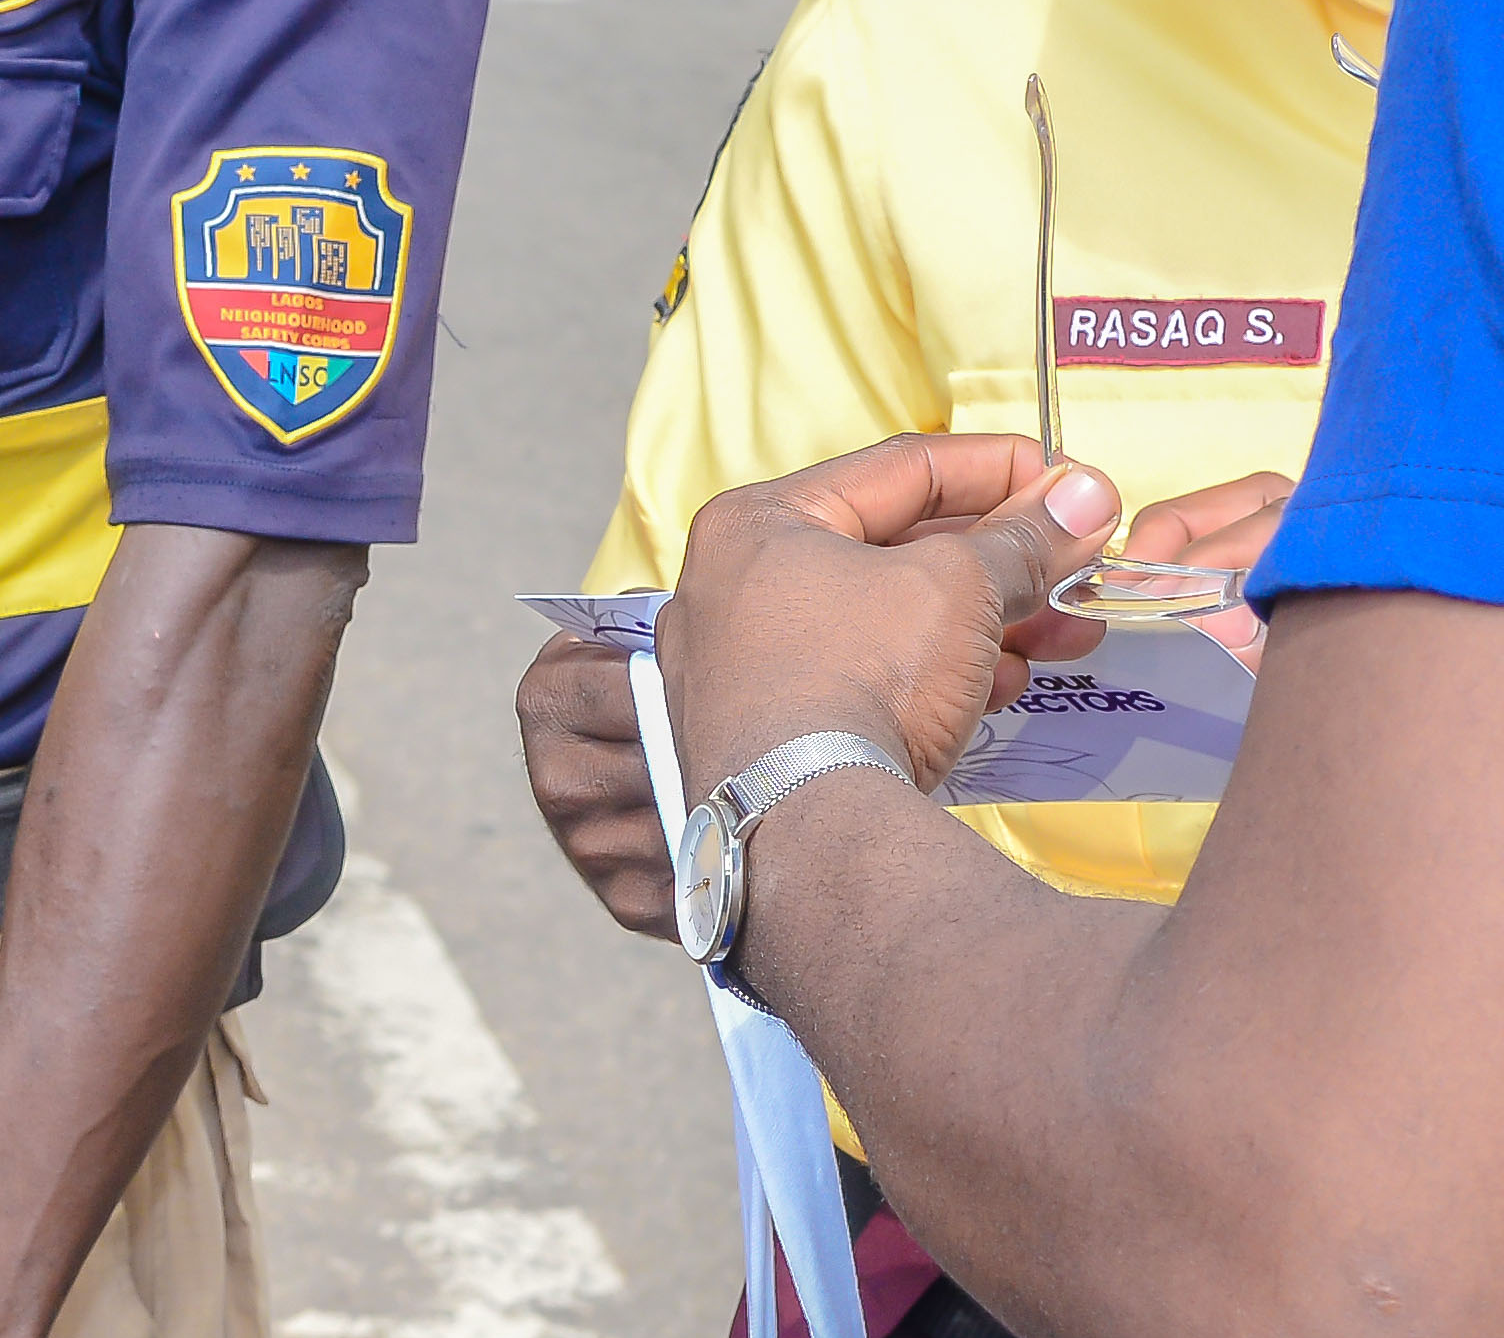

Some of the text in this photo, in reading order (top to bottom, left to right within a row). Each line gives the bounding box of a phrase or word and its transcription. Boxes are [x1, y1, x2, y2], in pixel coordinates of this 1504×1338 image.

[271, 293, 325, 311] LAGOS
[220, 308, 367, 335] NEIGHBOURHOOD
[1069, 308, 1284, 349] RASAQ S.
[240, 326, 351, 351] SAFETY CORPS
[1032, 674, 1100, 691] our
